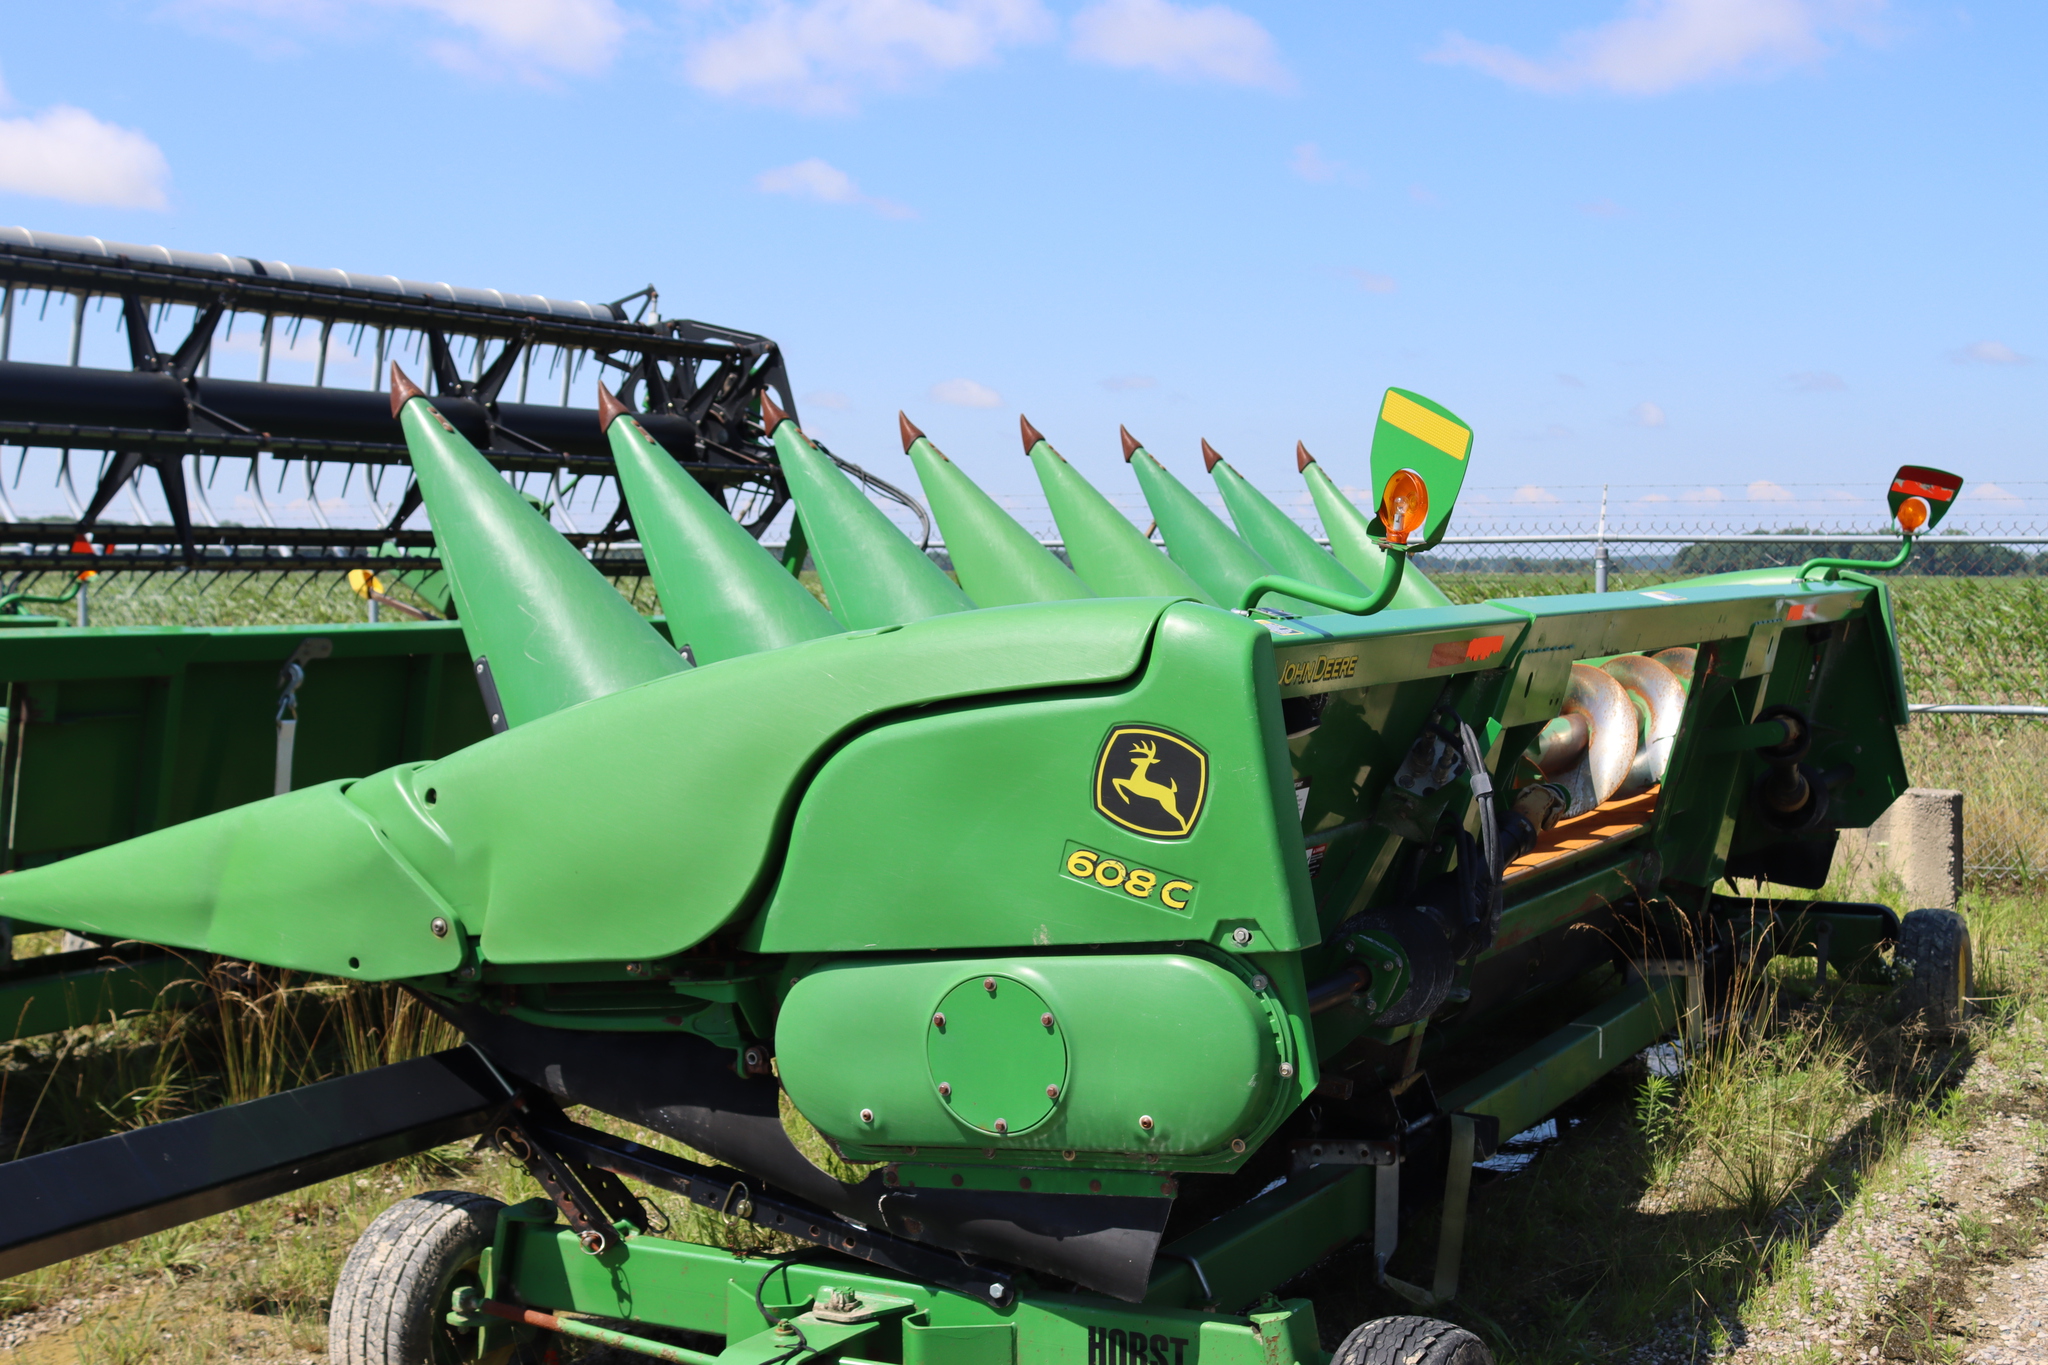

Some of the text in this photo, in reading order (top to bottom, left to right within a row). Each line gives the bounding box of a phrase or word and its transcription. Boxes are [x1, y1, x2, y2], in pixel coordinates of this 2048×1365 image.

[1278, 655, 1359, 685] JOHN DEERE
[1088, 1325, 1189, 1365] HORST
